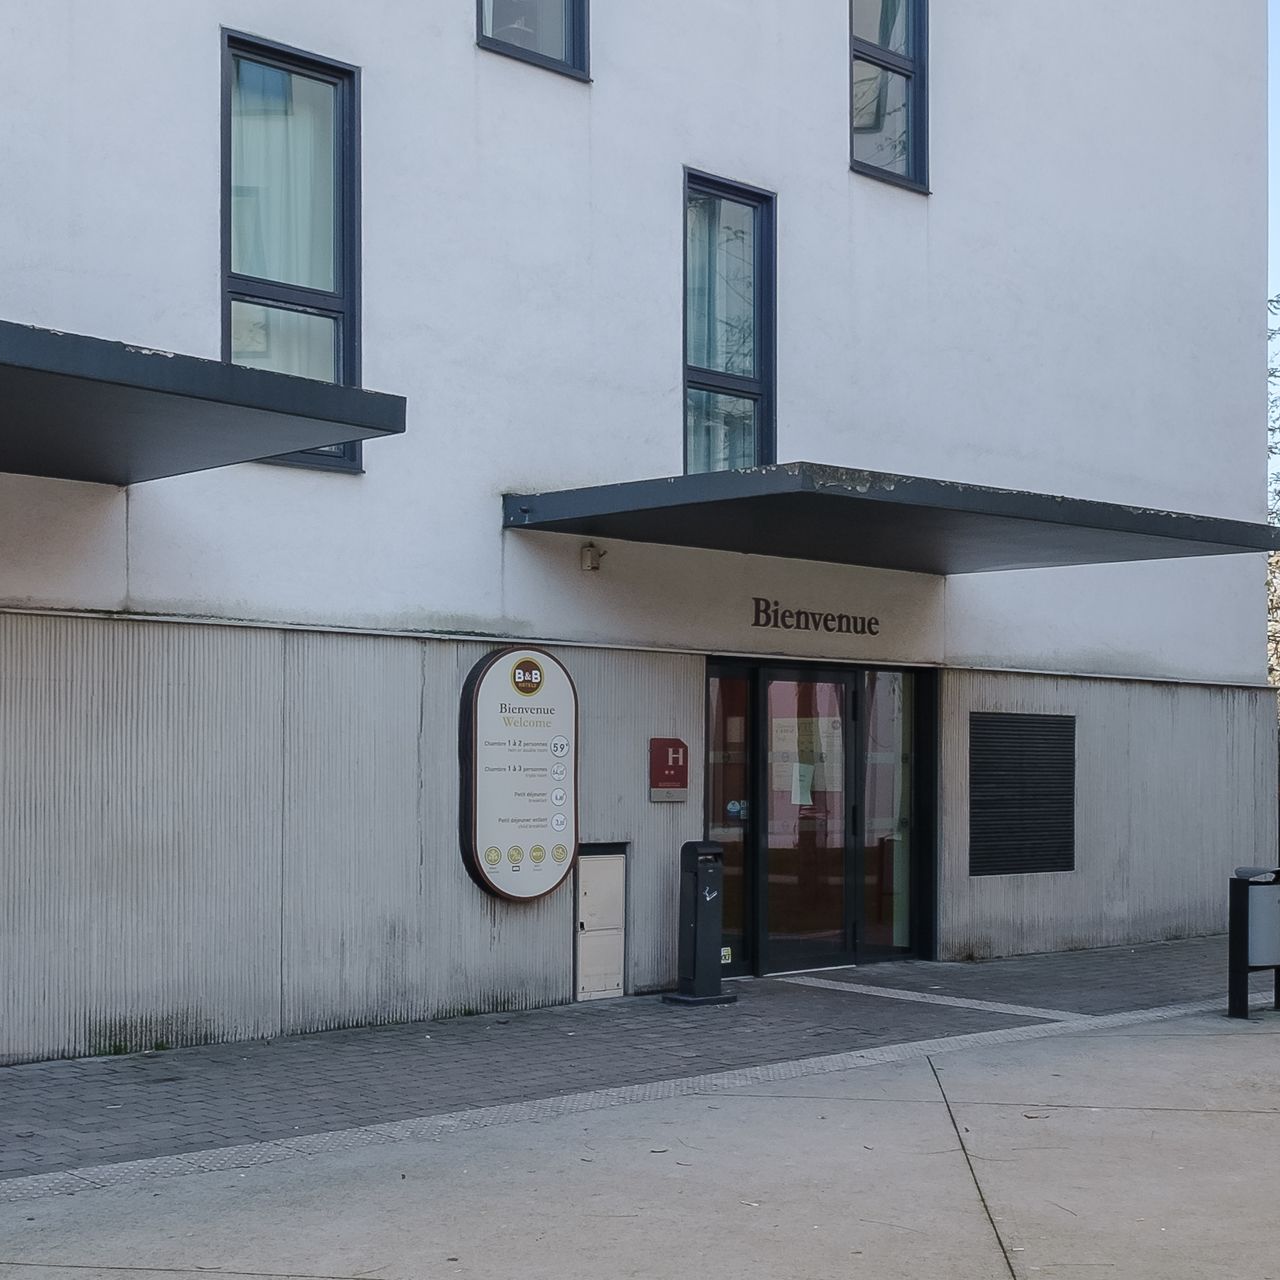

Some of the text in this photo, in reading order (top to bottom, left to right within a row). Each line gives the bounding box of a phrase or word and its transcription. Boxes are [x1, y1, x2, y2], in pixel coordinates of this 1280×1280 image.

[750, 596, 880, 636] Bienvenue
[515, 669, 541, 683] B&B
[498, 702, 556, 715] Bienvenue
[502, 716, 552, 728] Welcome
[667, 747, 684, 766] H
